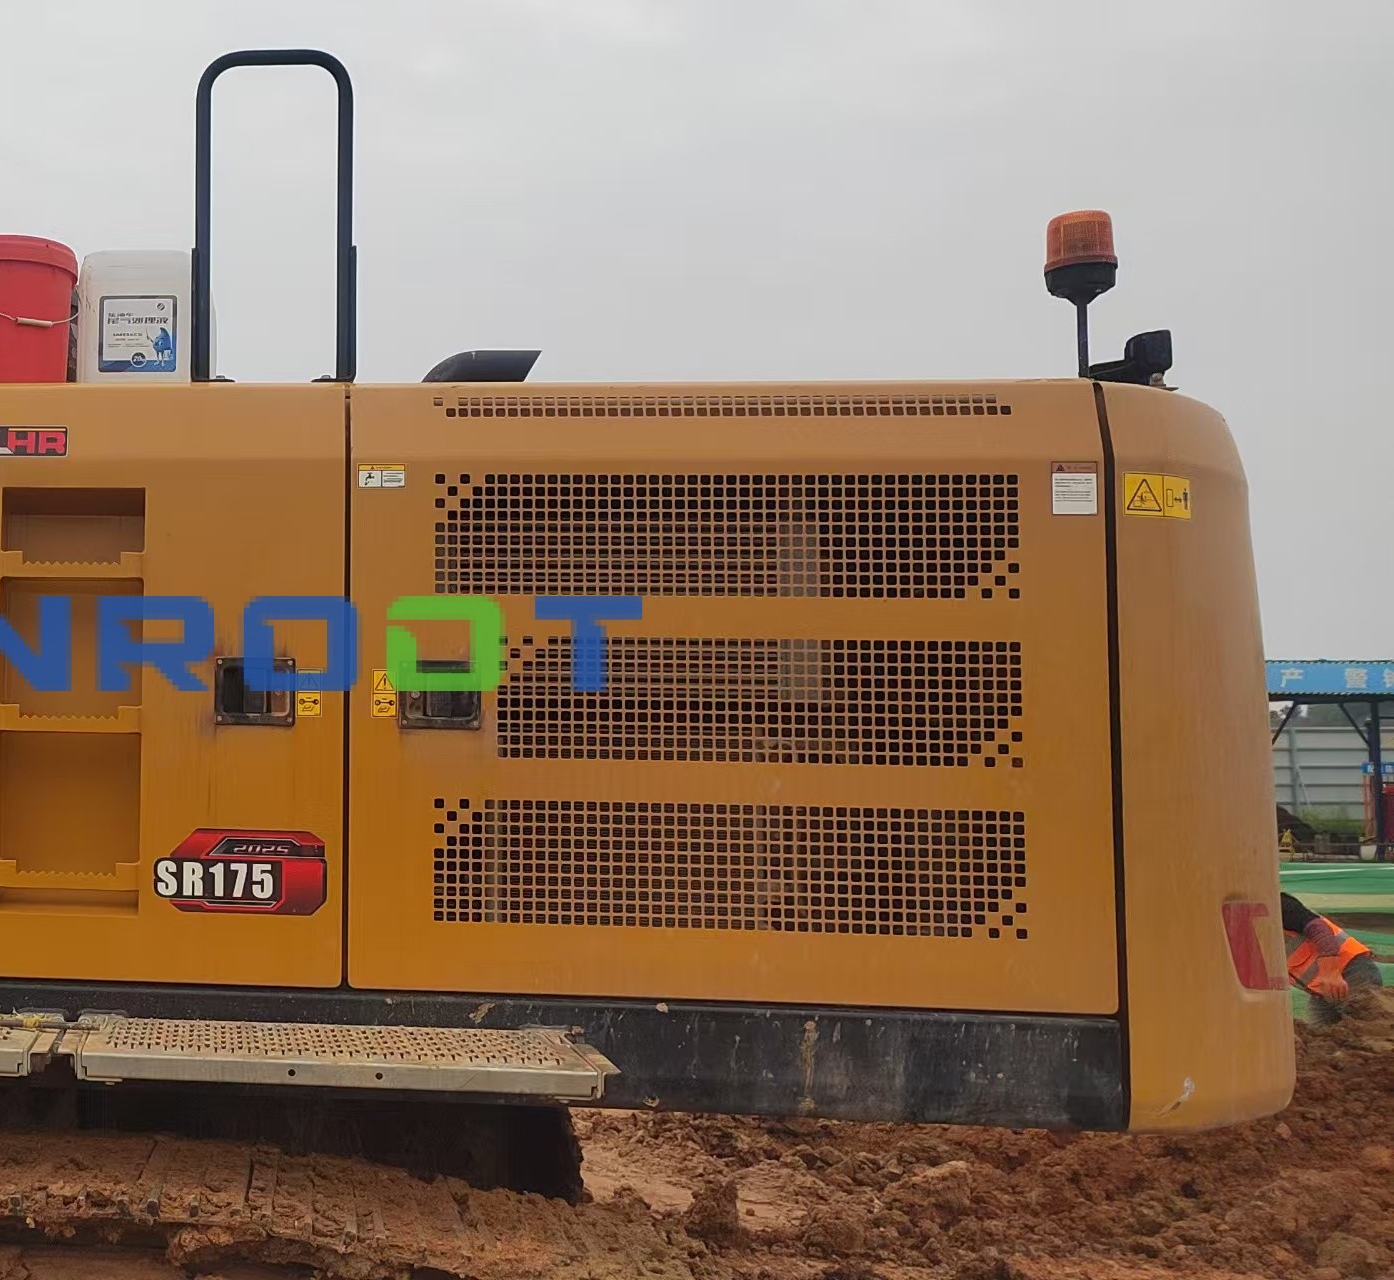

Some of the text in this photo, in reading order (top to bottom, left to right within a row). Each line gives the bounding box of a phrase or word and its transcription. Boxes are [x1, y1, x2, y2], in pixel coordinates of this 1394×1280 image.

[1281, 668, 1304, 688] 产
[233, 843, 291, 855] 2025
[157, 860, 273, 898] SR175
